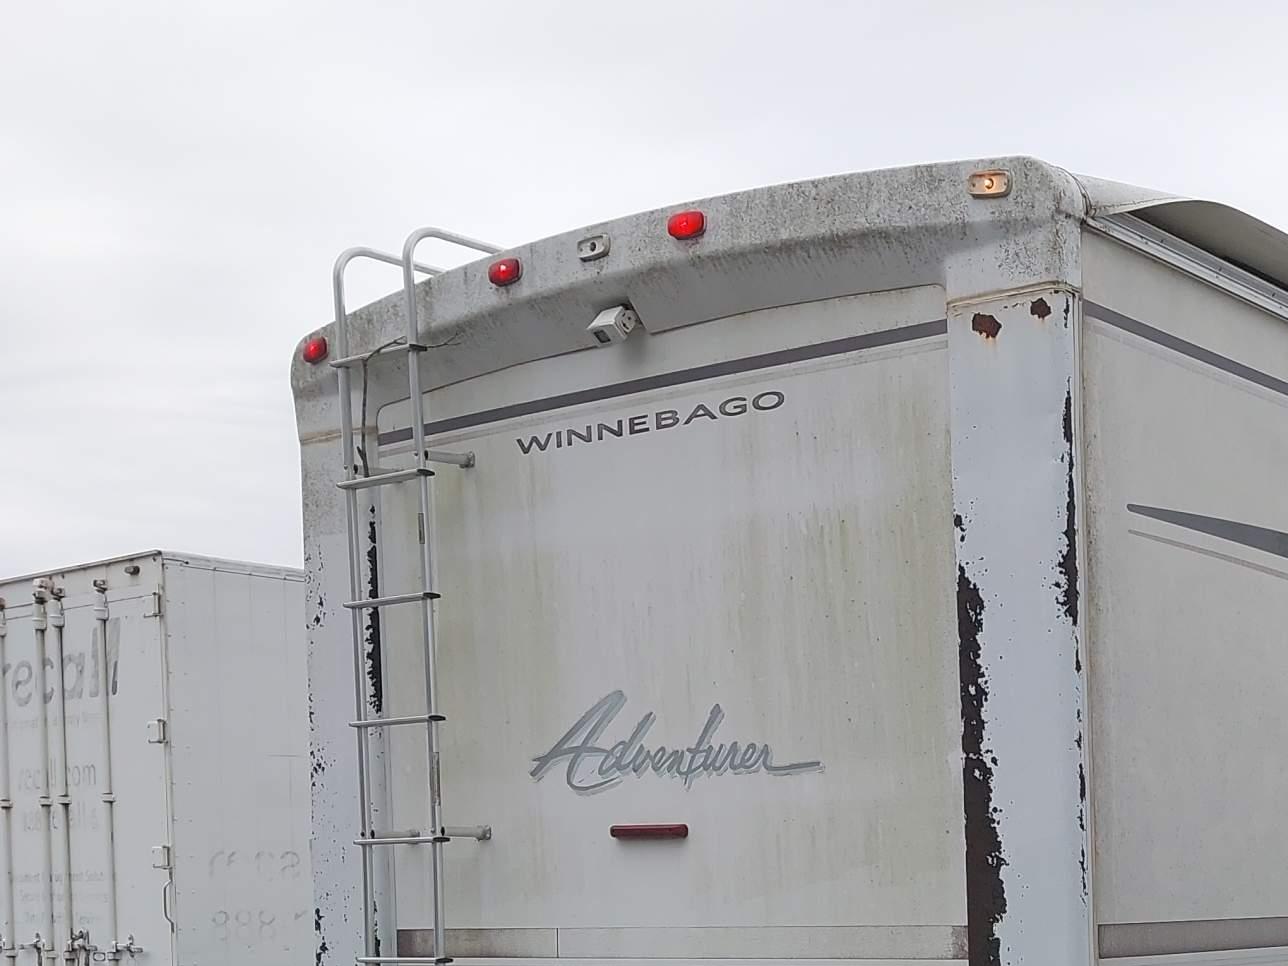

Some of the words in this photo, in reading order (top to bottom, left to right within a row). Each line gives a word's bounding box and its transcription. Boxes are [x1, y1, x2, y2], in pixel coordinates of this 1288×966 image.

[515, 391, 785, 455] WINNEBAGO
[18, 758, 97, 791] recllom
[529, 690, 824, 795] Adventurer
